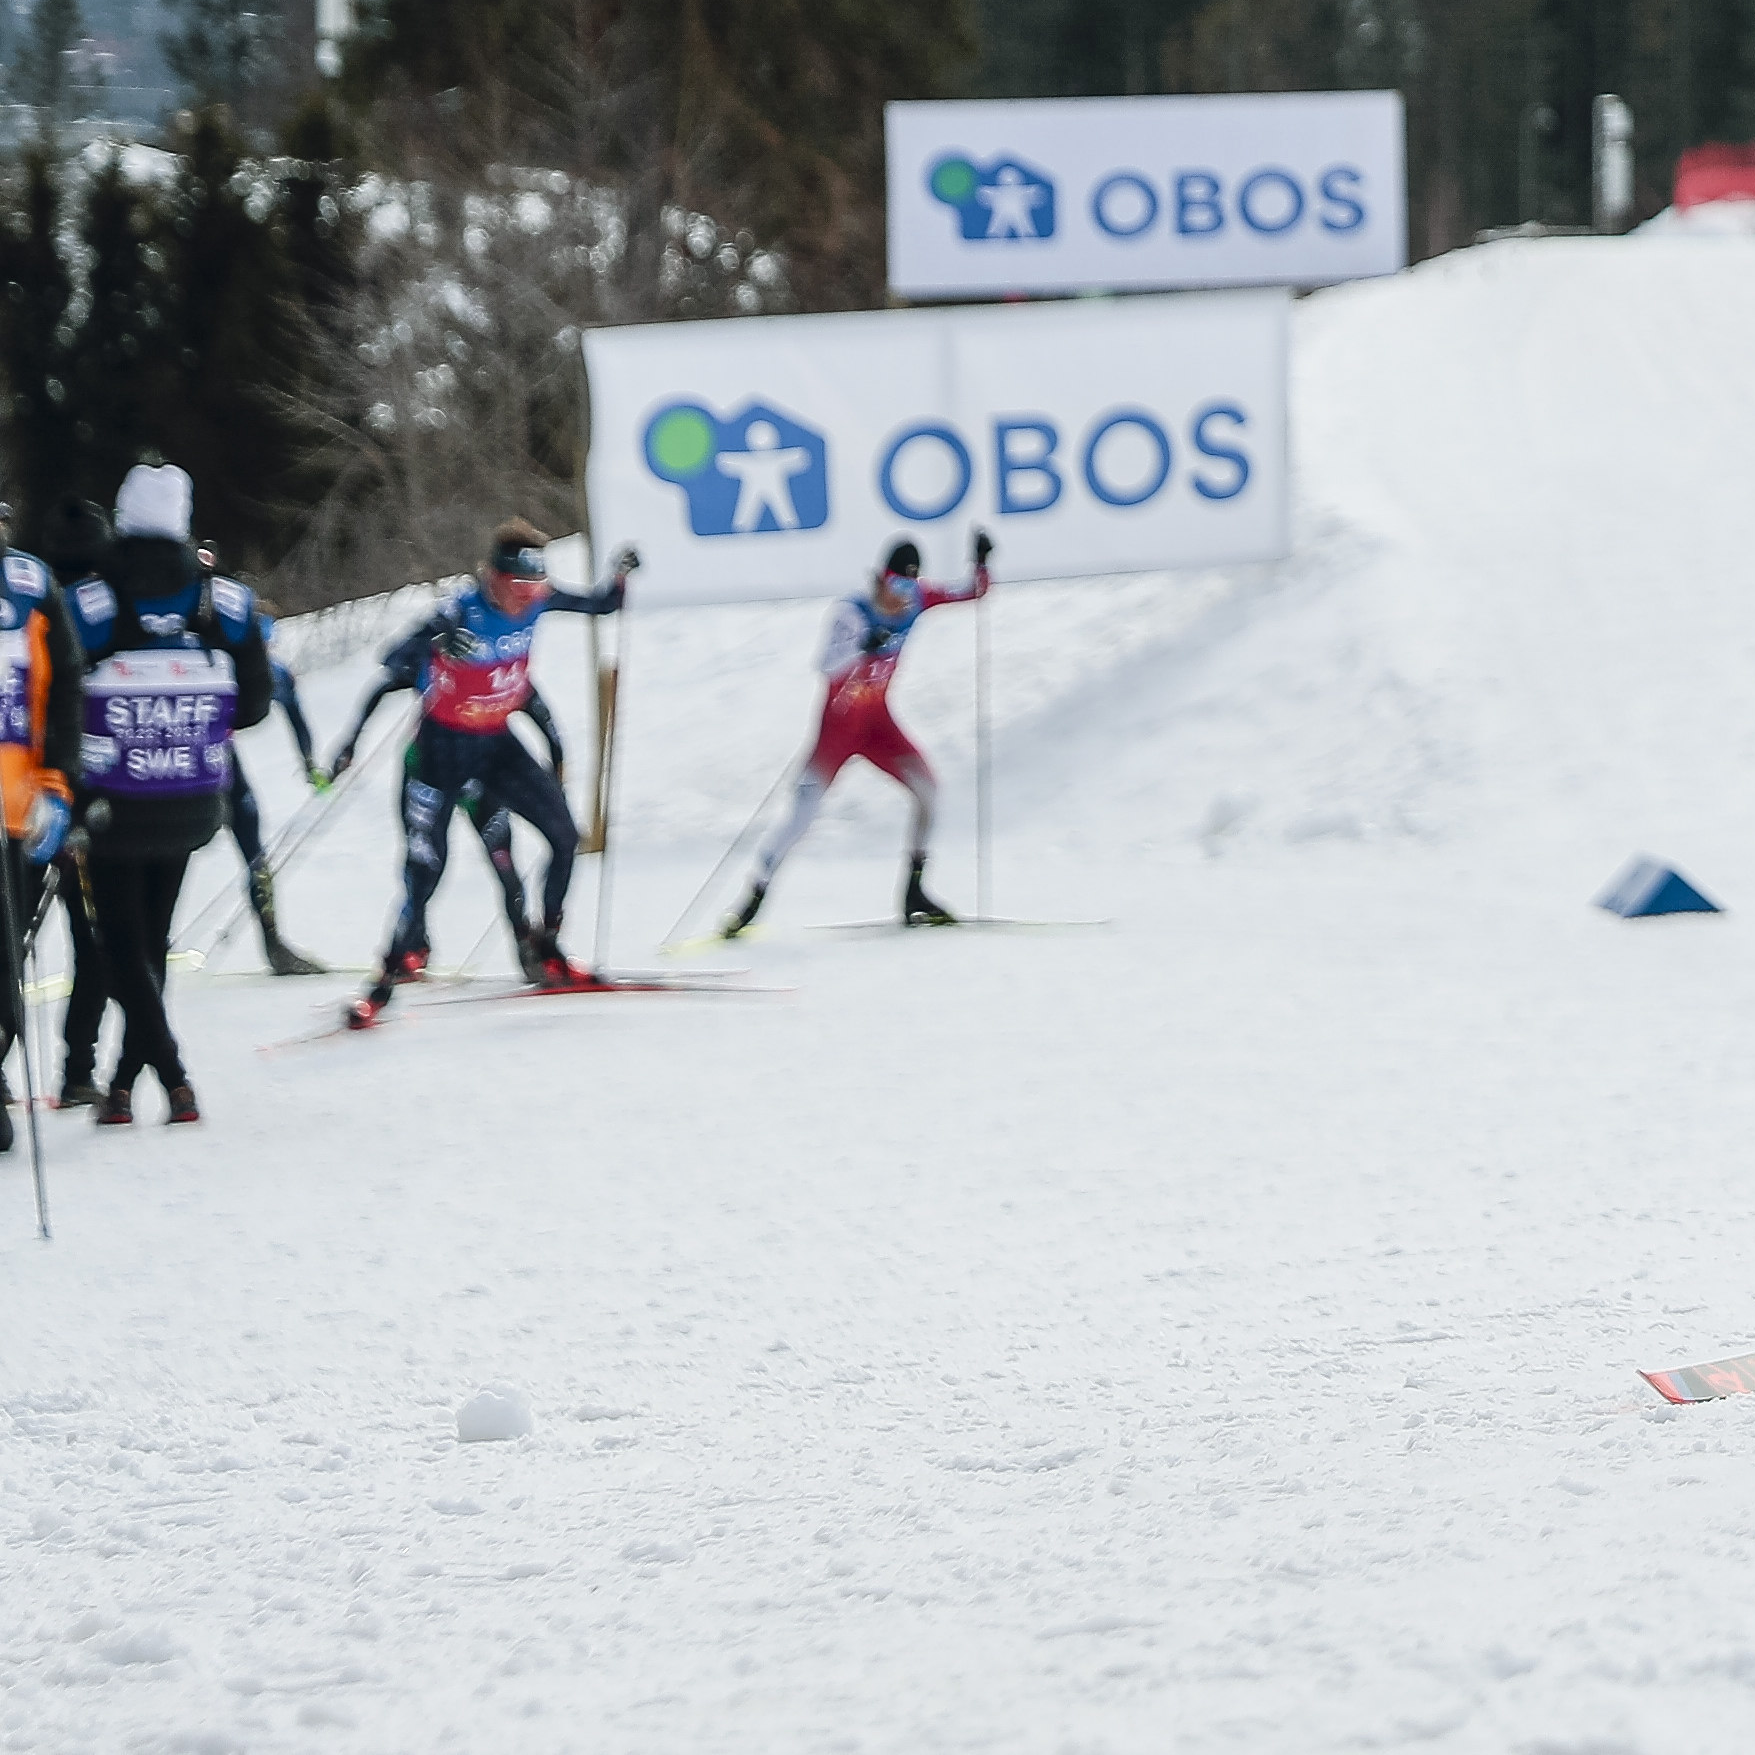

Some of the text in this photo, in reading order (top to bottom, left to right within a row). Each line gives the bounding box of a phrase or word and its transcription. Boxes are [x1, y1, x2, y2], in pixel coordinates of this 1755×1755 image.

[1092, 166, 1365, 237] OBOS
[880, 401, 1251, 521] OBOS
[104, 695, 221, 731] STAFF
[127, 746, 193, 776] SWE
